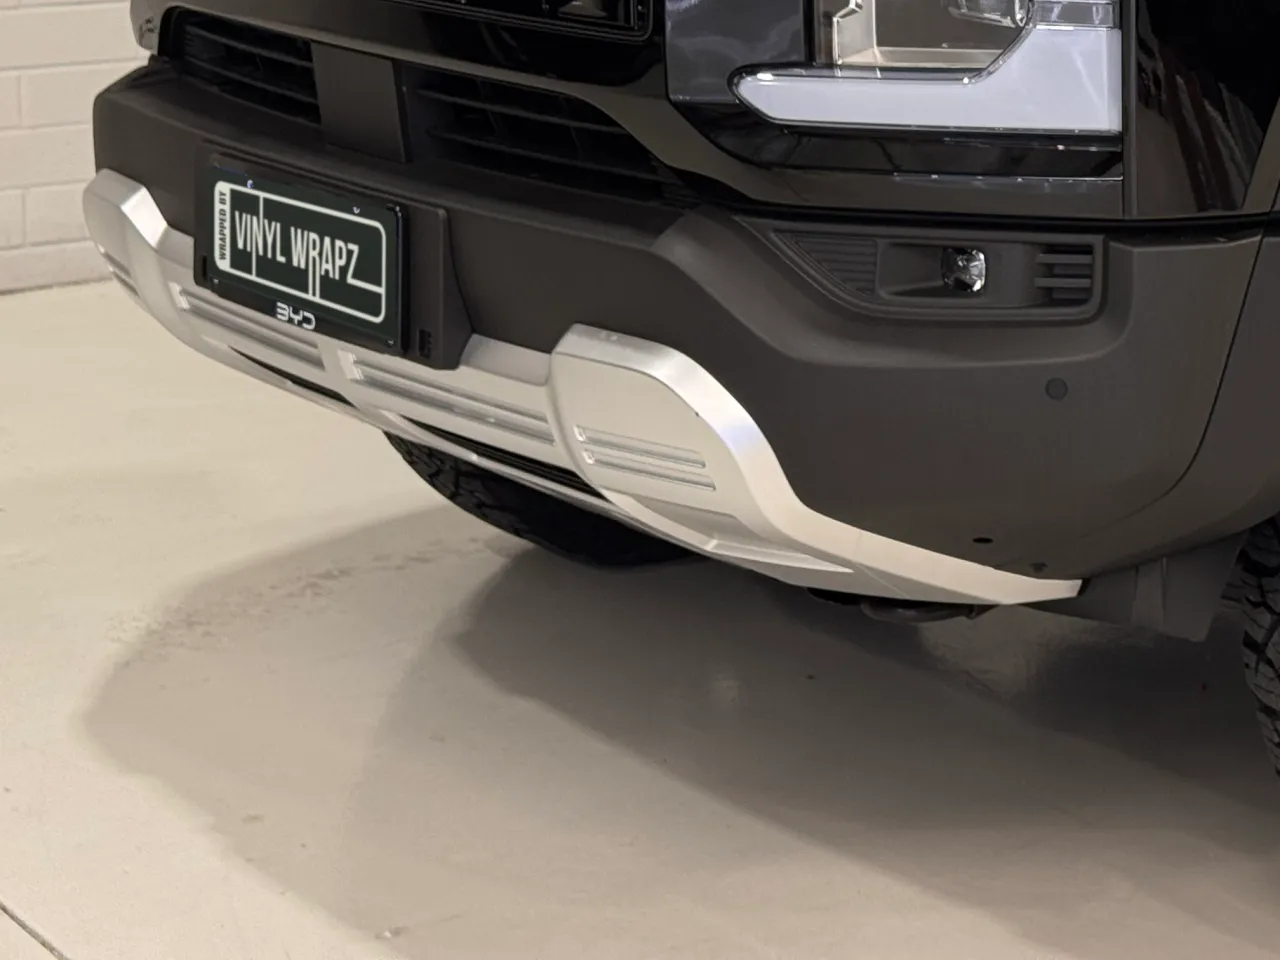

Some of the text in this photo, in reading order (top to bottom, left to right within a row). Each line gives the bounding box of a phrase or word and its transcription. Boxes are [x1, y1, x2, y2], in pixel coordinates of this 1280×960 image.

[218, 191, 228, 261] WRAPPED BY
[235, 208, 360, 288] VINYL WRAPZ
[276, 301, 316, 330] BYD
